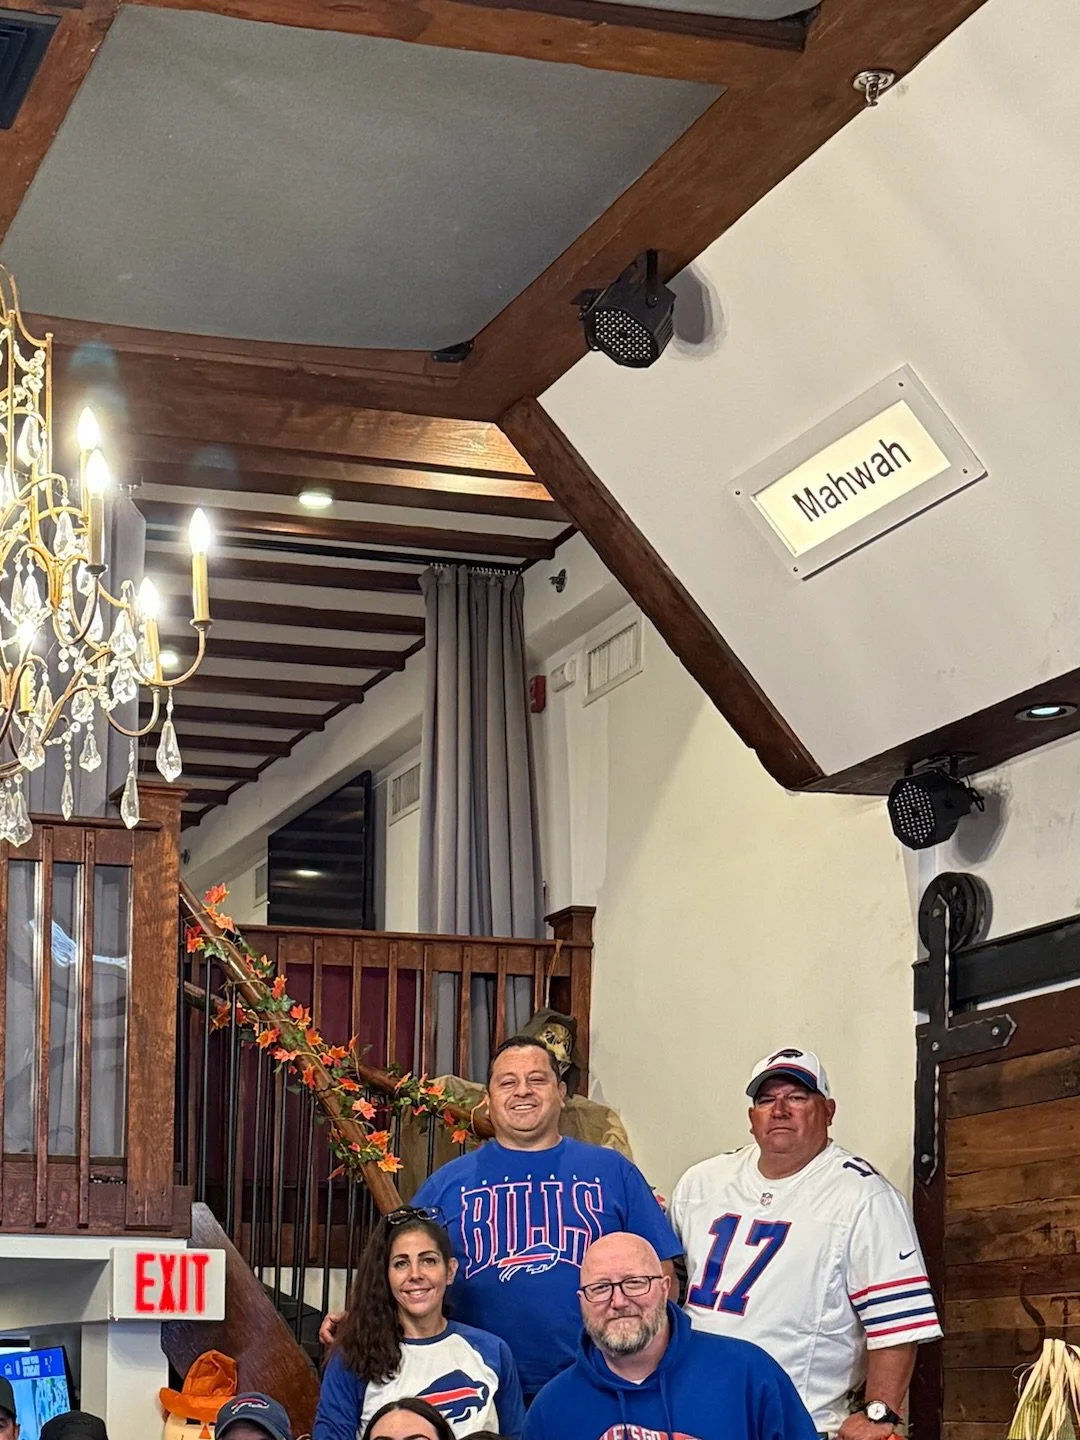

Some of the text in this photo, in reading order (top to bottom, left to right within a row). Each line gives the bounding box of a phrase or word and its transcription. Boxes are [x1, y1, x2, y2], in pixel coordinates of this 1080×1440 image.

[792, 439, 911, 522] Mahwah
[461, 1181, 603, 1279] BILLS
[688, 1212, 792, 1316] 17
[135, 1253, 210, 1313] EXIT
